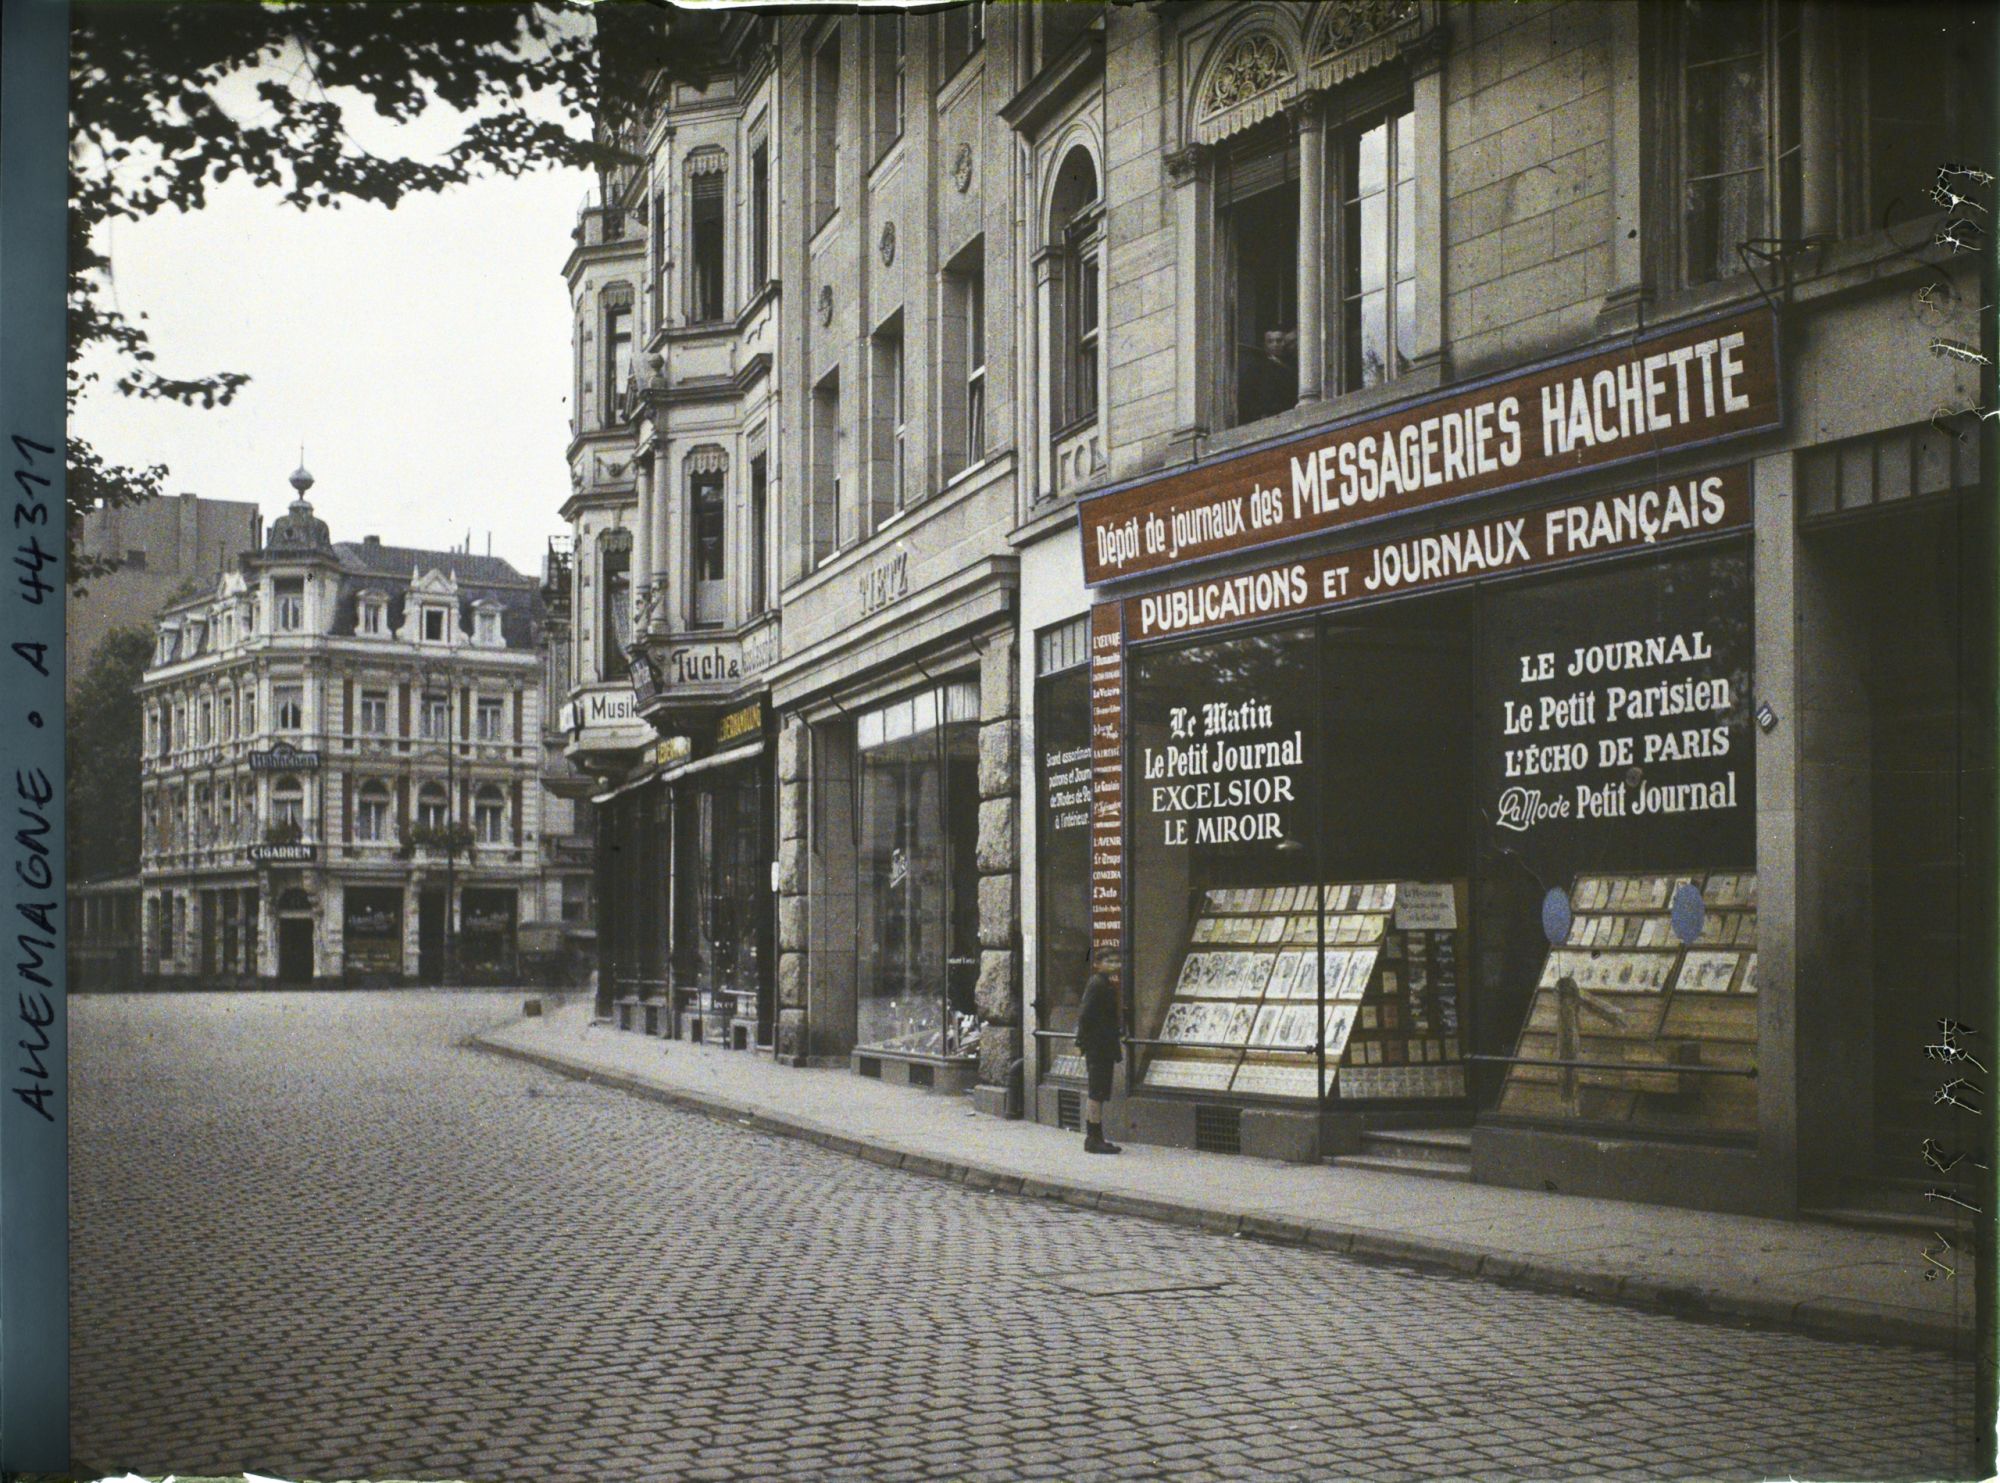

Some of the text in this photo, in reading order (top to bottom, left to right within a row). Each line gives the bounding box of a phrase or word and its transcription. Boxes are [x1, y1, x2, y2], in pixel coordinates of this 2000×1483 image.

[1096, 331, 1749, 569] Dépôt de journaux des MESSAGERIES HACHETTE
[1141, 476, 1726, 636] PUBLICATIONS ET JOURNAUX FRANÇAIS
[859, 551, 908, 616] TIETZ
[13, 640, 50, 678] A
[671, 646, 726, 683] Tuch
[727, 658, 742, 679] &
[1520, 631, 1713, 683] LE JOURNAL
[591, 695, 638, 720] Musik
[1170, 696, 1274, 740] Le Matin
[1503, 676, 1732, 736] Le Petit Parisien
[1757, 707, 1773, 727] 10
[1062, 745, 1092, 764] assortimen
[1144, 730, 1304, 780] Le Petit Journal
[1504, 726, 1731, 778] L'ÉCHO DE PARIS
[1151, 774, 1295, 813] EXCELSIOR
[1576, 782, 1627, 820] Petit
[1631, 770, 1738, 816] Journal
[251, 846, 311, 859] CIGARREN
[1164, 812, 1283, 846] LE MIROIR
[10, 768, 58, 1123] ALLEMAGNE
